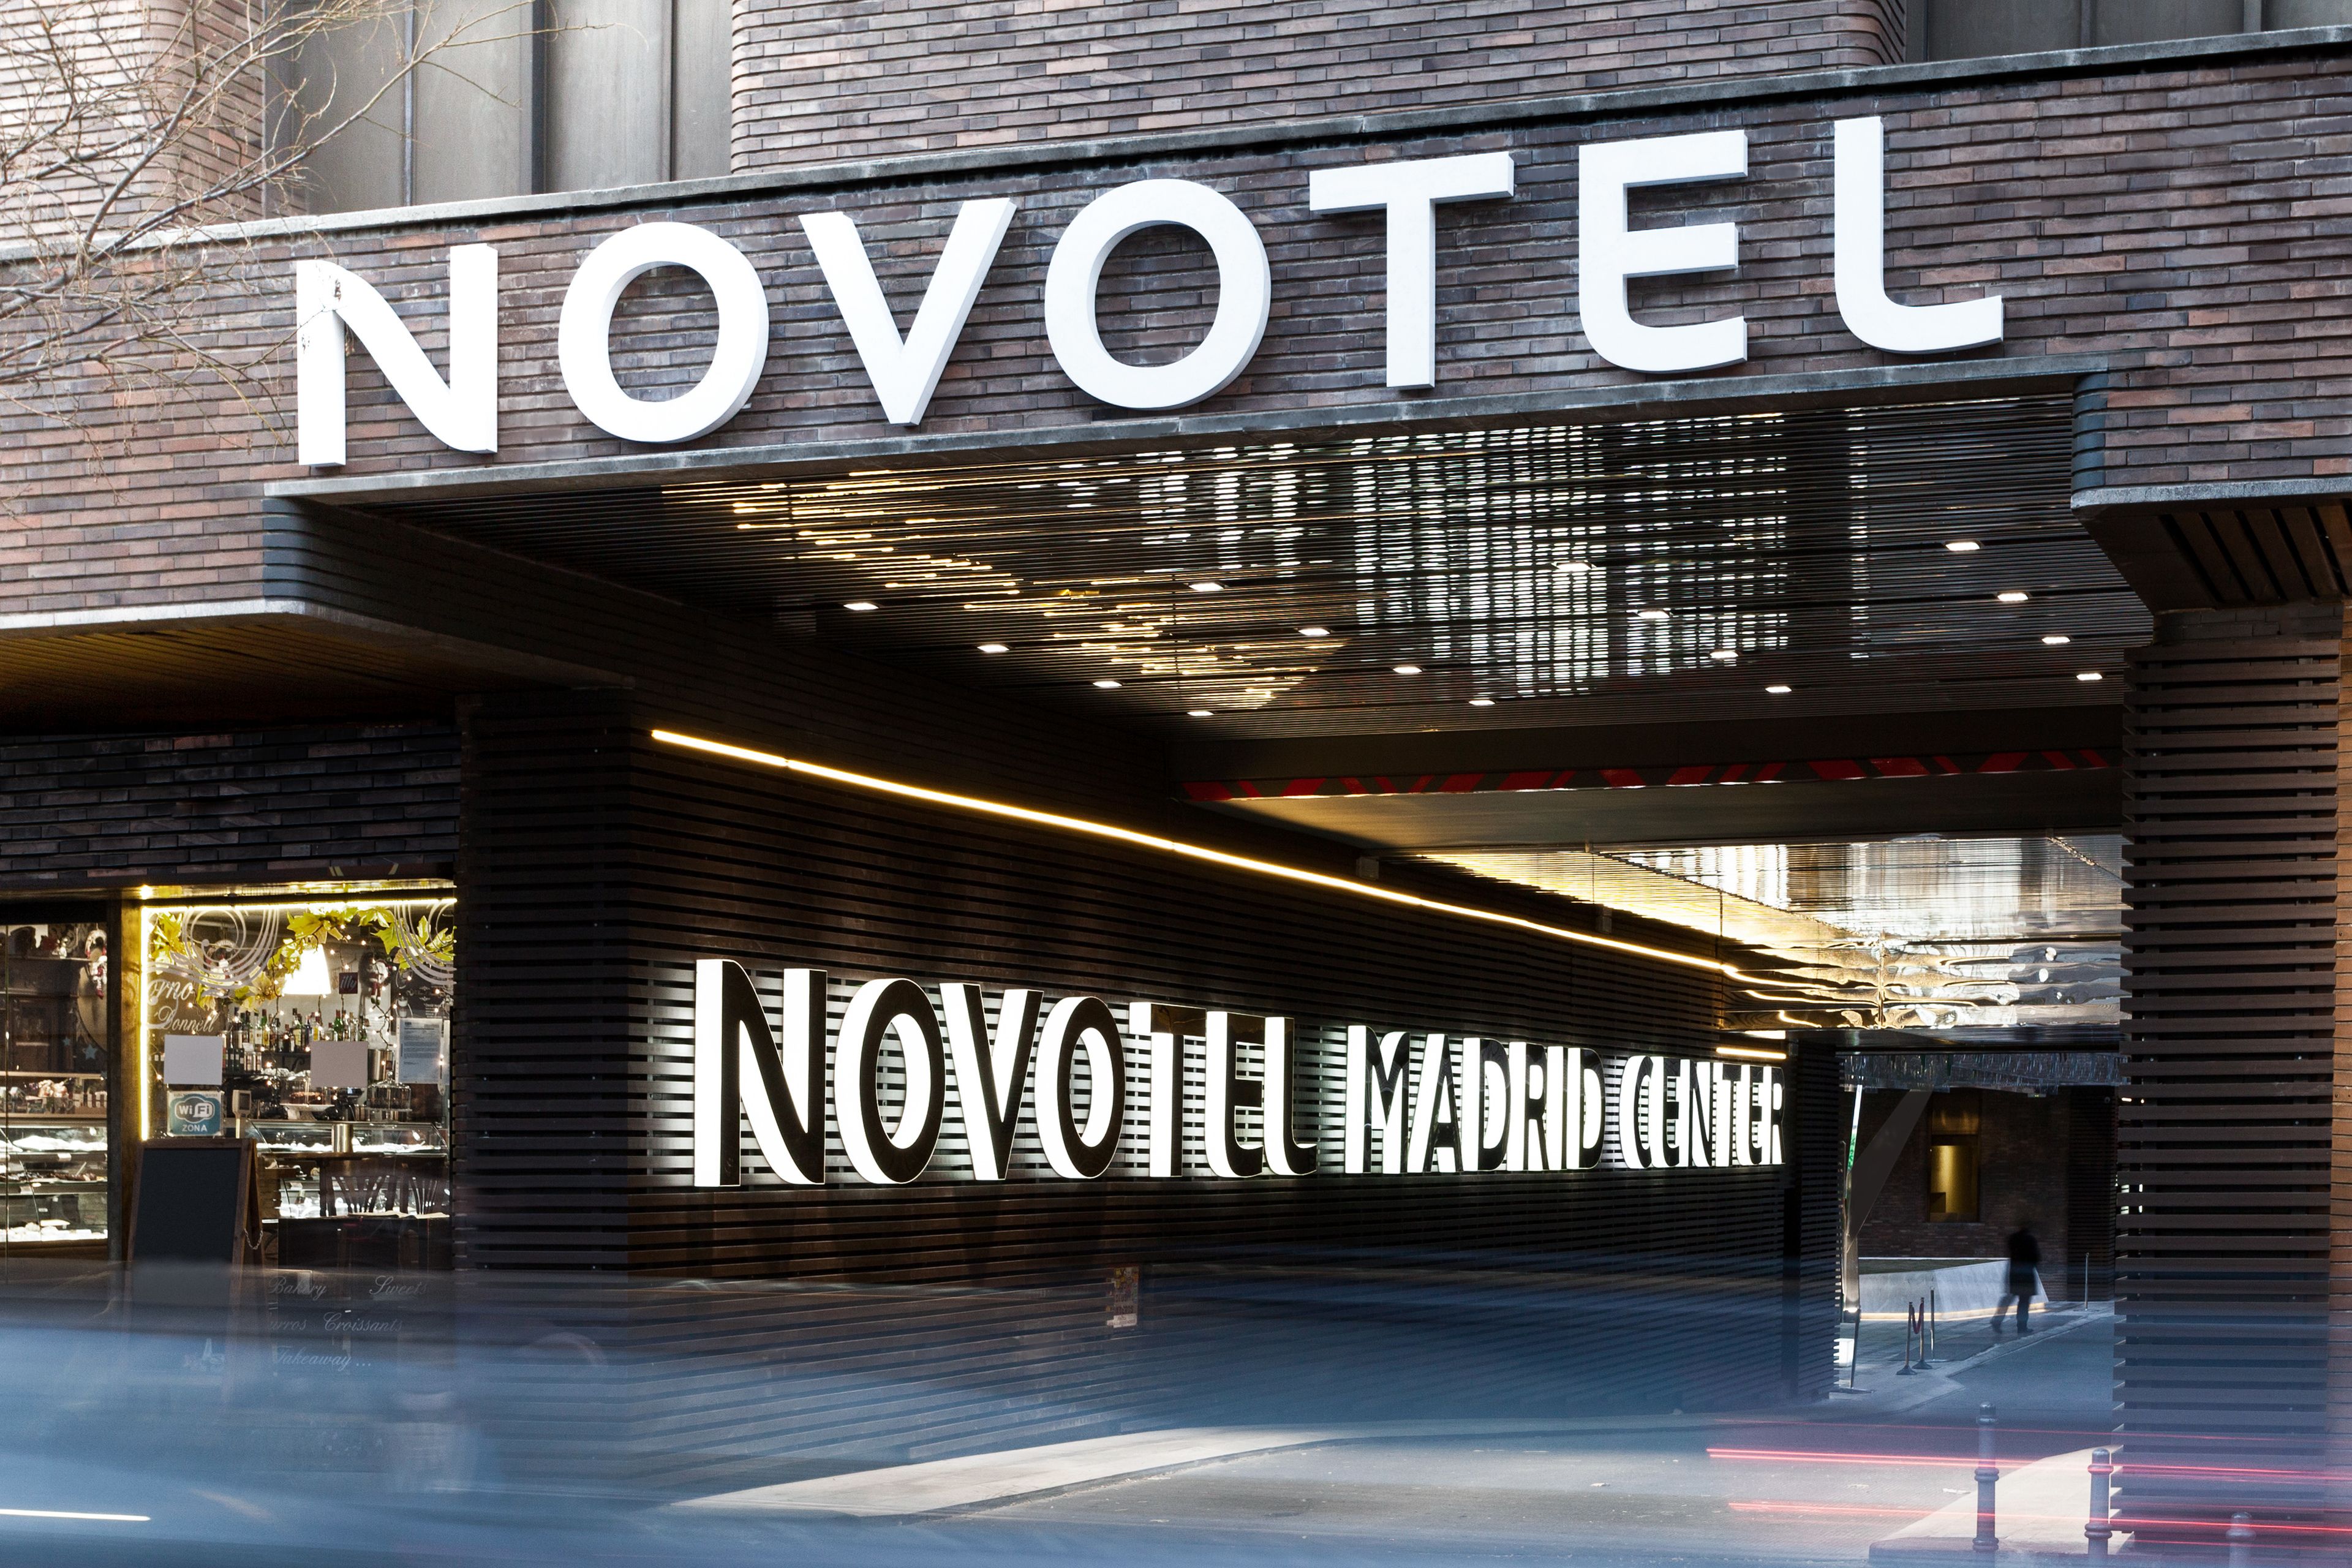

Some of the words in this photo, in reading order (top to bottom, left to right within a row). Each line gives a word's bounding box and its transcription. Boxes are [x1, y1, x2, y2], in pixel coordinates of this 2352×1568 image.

[296, 115, 2004, 468] NOVOTEL
[148, 980, 196, 1001] orno
[341, 975, 357, 991] illy
[694, 958, 1317, 1188] NOVOTEL
[1344, 1024, 1607, 1175] MADRID
[1619, 1055, 1786, 1169] CENTER
[369, 1275, 426, 1295] Sweets
[270, 1317, 307, 1331] urros
[323, 1311, 403, 1332] Croissants
